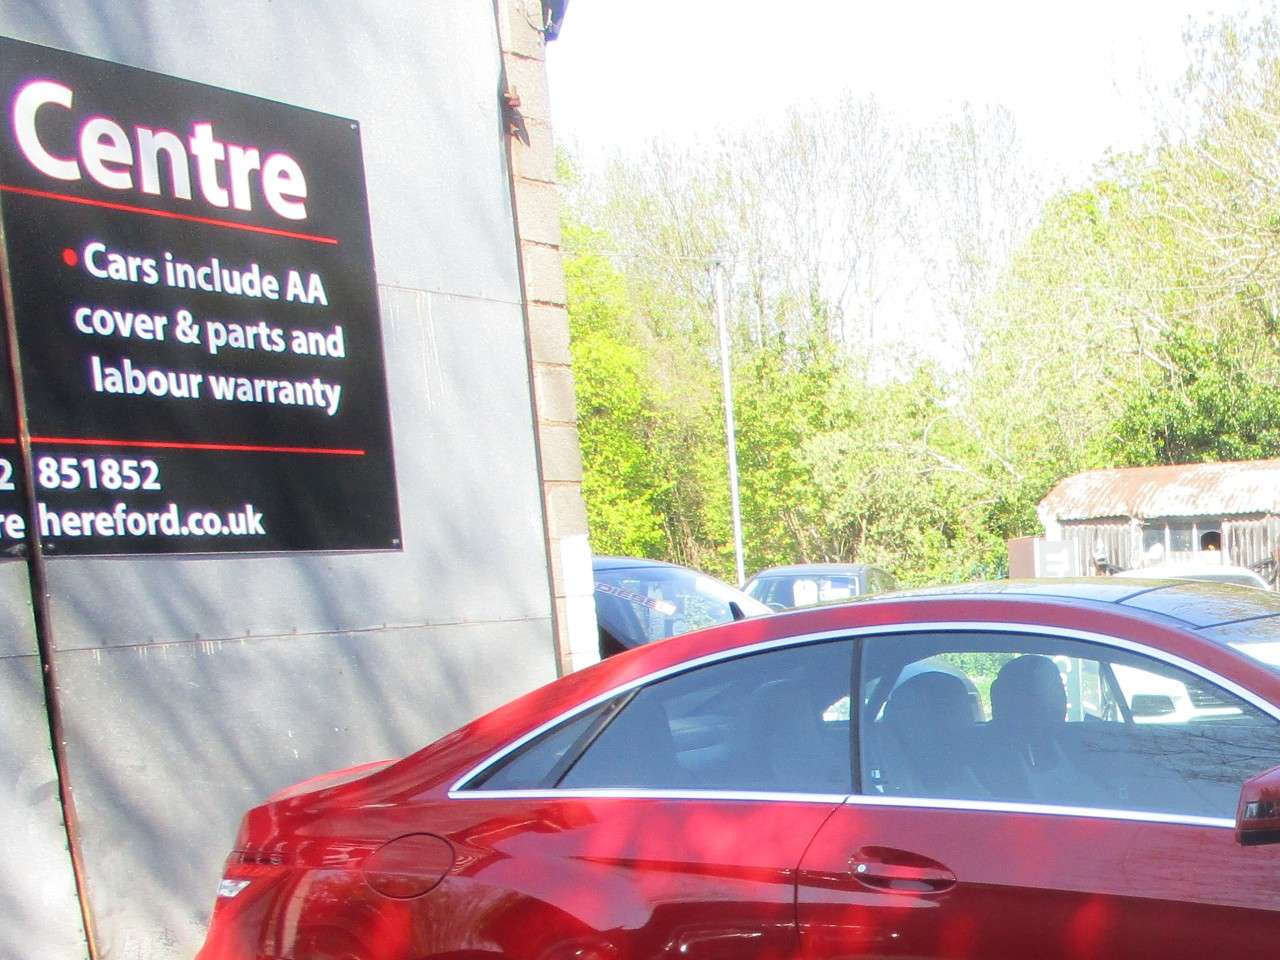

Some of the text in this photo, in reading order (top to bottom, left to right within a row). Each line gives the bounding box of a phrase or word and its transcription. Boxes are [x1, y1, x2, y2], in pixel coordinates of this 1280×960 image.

[13, 80, 308, 221] Centre
[83, 241, 328, 306] Cars include AA
[74, 305, 346, 358] cover & parts and
[91, 355, 341, 416] labour warranty
[37, 456, 161, 490] 851852
[37, 502, 266, 537] hereford.co.uk
